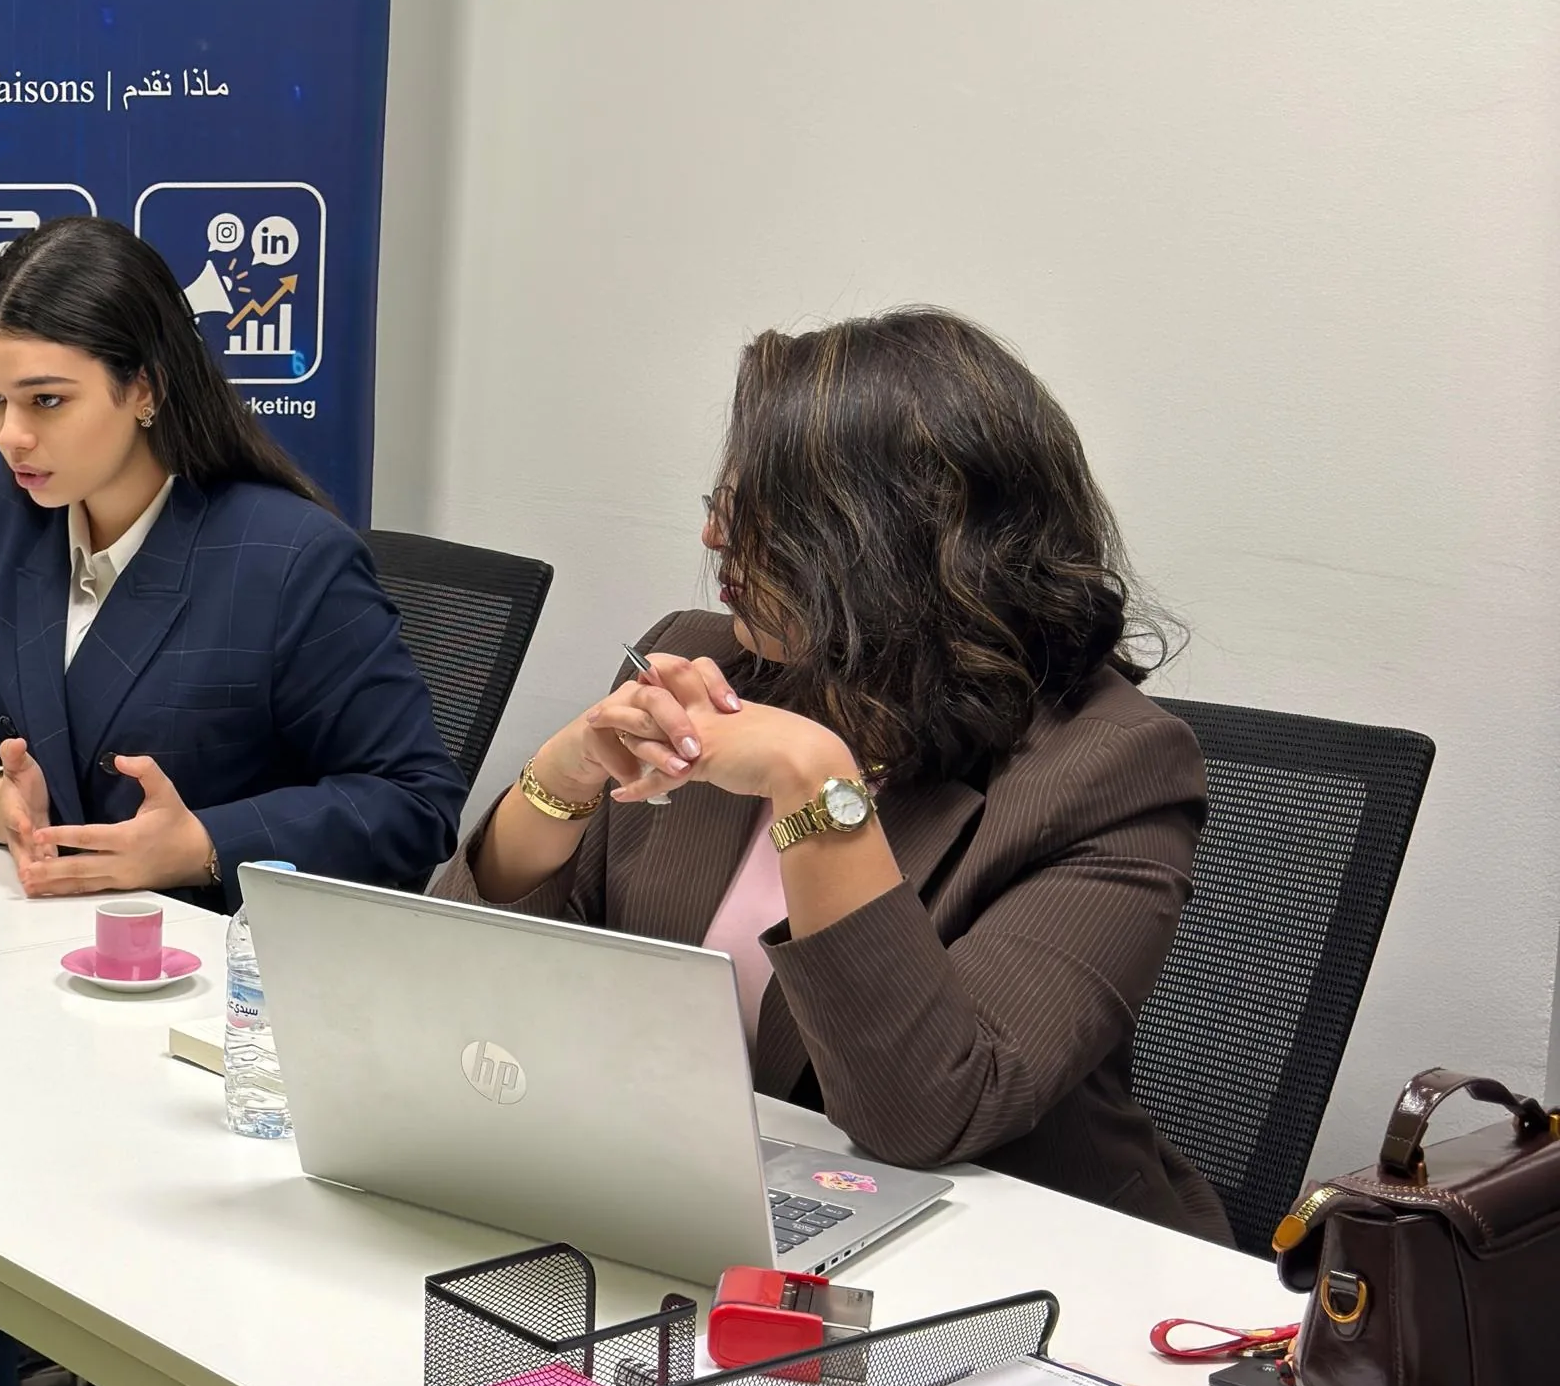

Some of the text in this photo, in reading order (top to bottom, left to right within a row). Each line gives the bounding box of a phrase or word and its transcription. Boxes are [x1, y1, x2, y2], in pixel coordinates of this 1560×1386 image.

[123, 68, 229, 110] ماذا نقدم
[260, 226, 289, 255] in
[246, 395, 316, 419] keting
[470, 1040, 520, 1104] hp
